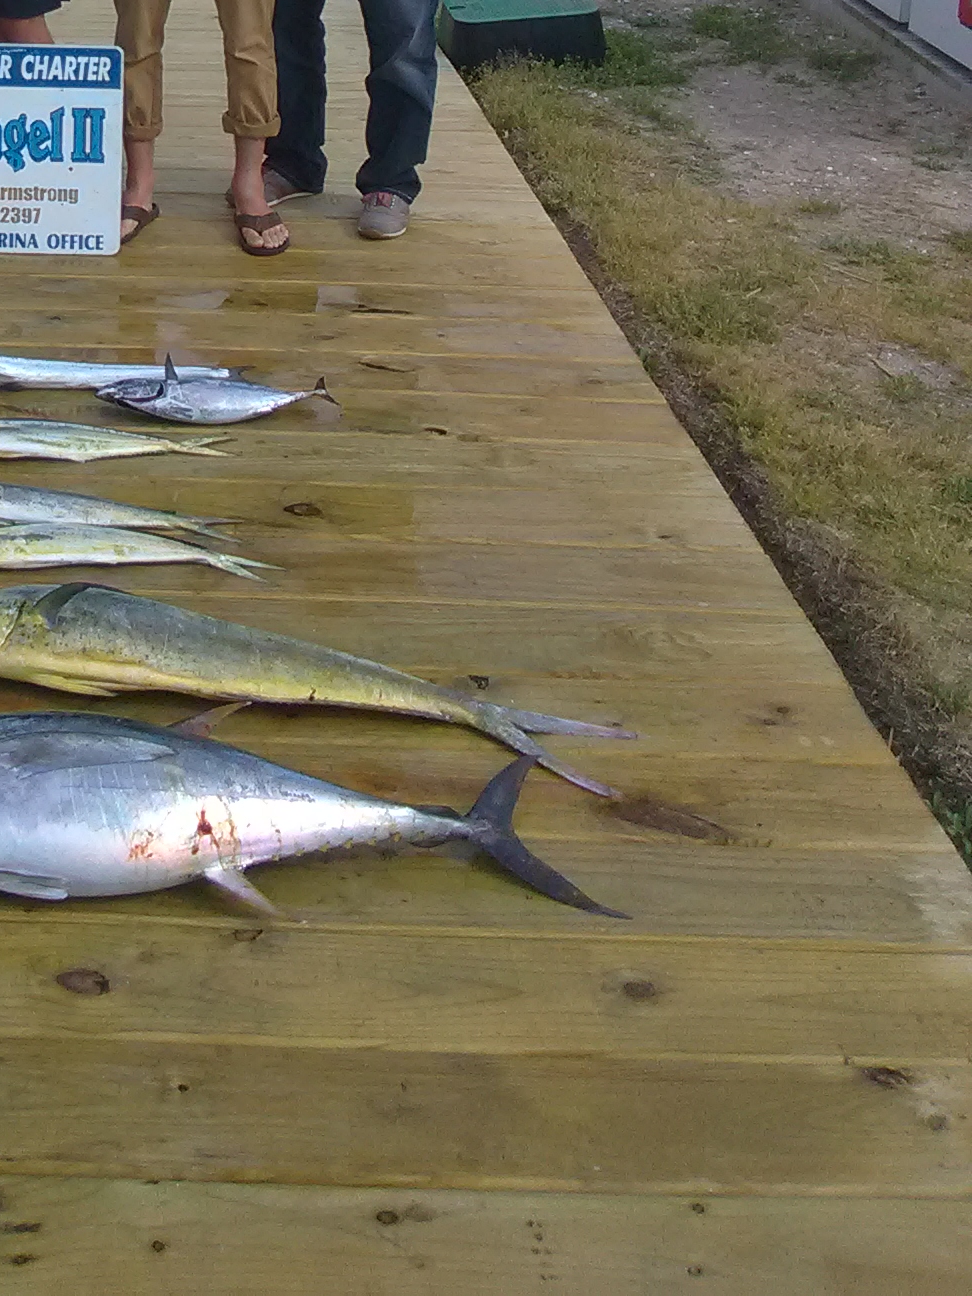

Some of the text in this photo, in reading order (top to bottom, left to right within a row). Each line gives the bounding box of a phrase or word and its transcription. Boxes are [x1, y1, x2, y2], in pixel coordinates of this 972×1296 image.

[21, 55, 111, 81] CHARTER
[70, 107, 105, 163] II
[47, 233, 104, 251] OFFICE
